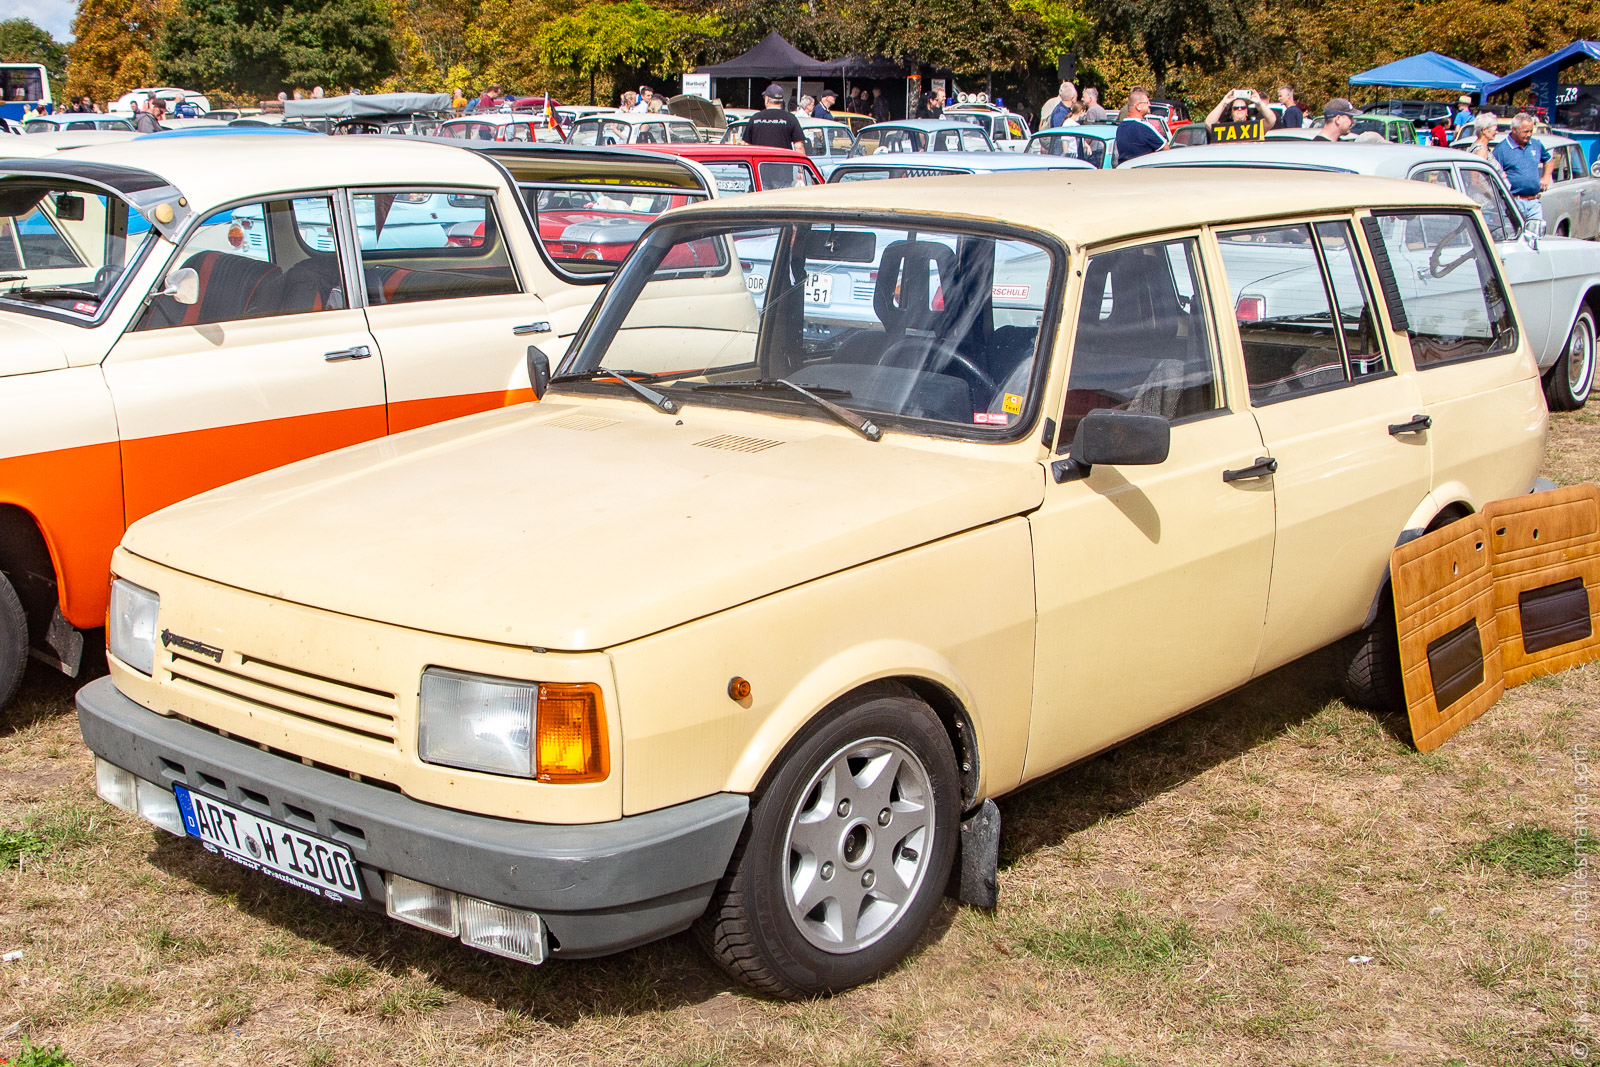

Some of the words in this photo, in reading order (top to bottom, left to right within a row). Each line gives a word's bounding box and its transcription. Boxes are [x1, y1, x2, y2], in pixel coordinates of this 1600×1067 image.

[1213, 123, 1258, 141] TAXI
[748, 277, 764, 290] DDR
[187, 815, 195, 828] D
[195, 799, 241, 849] ART
[255, 822, 279, 865] W
[282, 833, 356, 891] 1300
